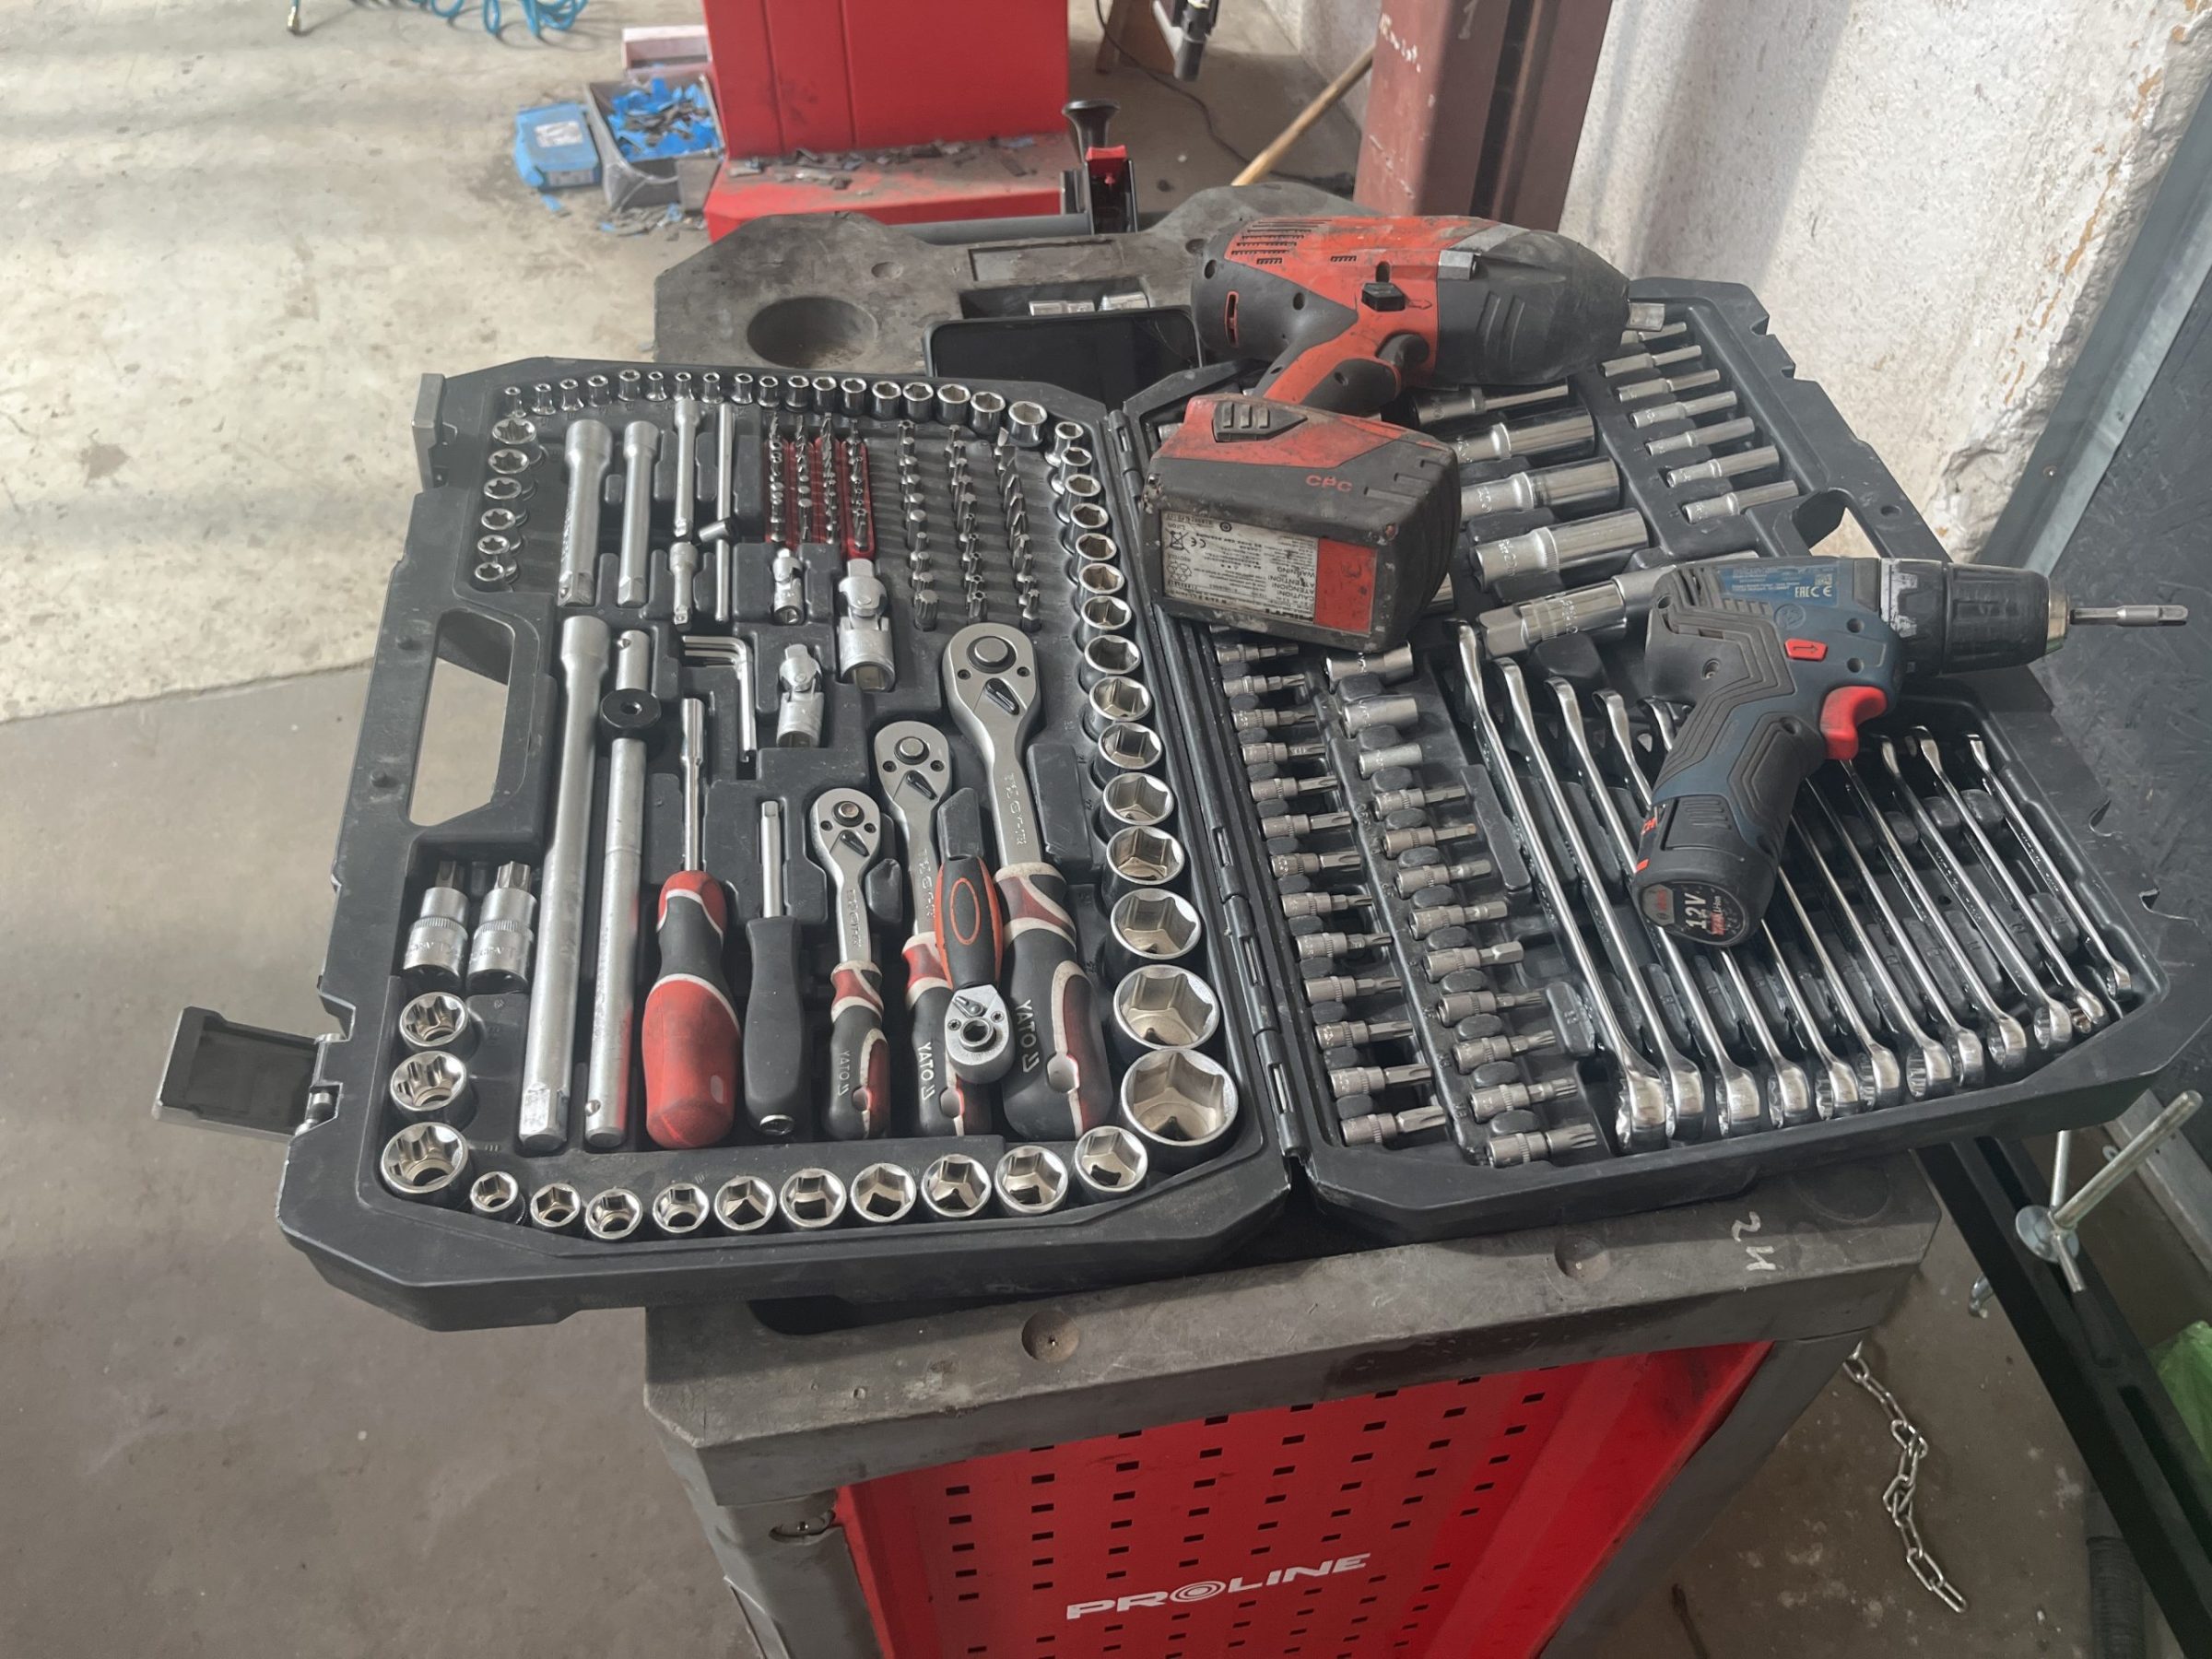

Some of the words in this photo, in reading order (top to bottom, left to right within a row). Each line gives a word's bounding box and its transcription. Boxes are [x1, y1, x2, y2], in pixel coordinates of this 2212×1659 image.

[1305, 474, 1354, 493] CPC
[1684, 892, 1707, 930] 12V
[1015, 998, 1037, 1049] YATO
[839, 1050, 851, 1080] YATO
[916, 1041, 935, 1081] YATO
[1066, 1552, 1371, 1620] PROLINE
